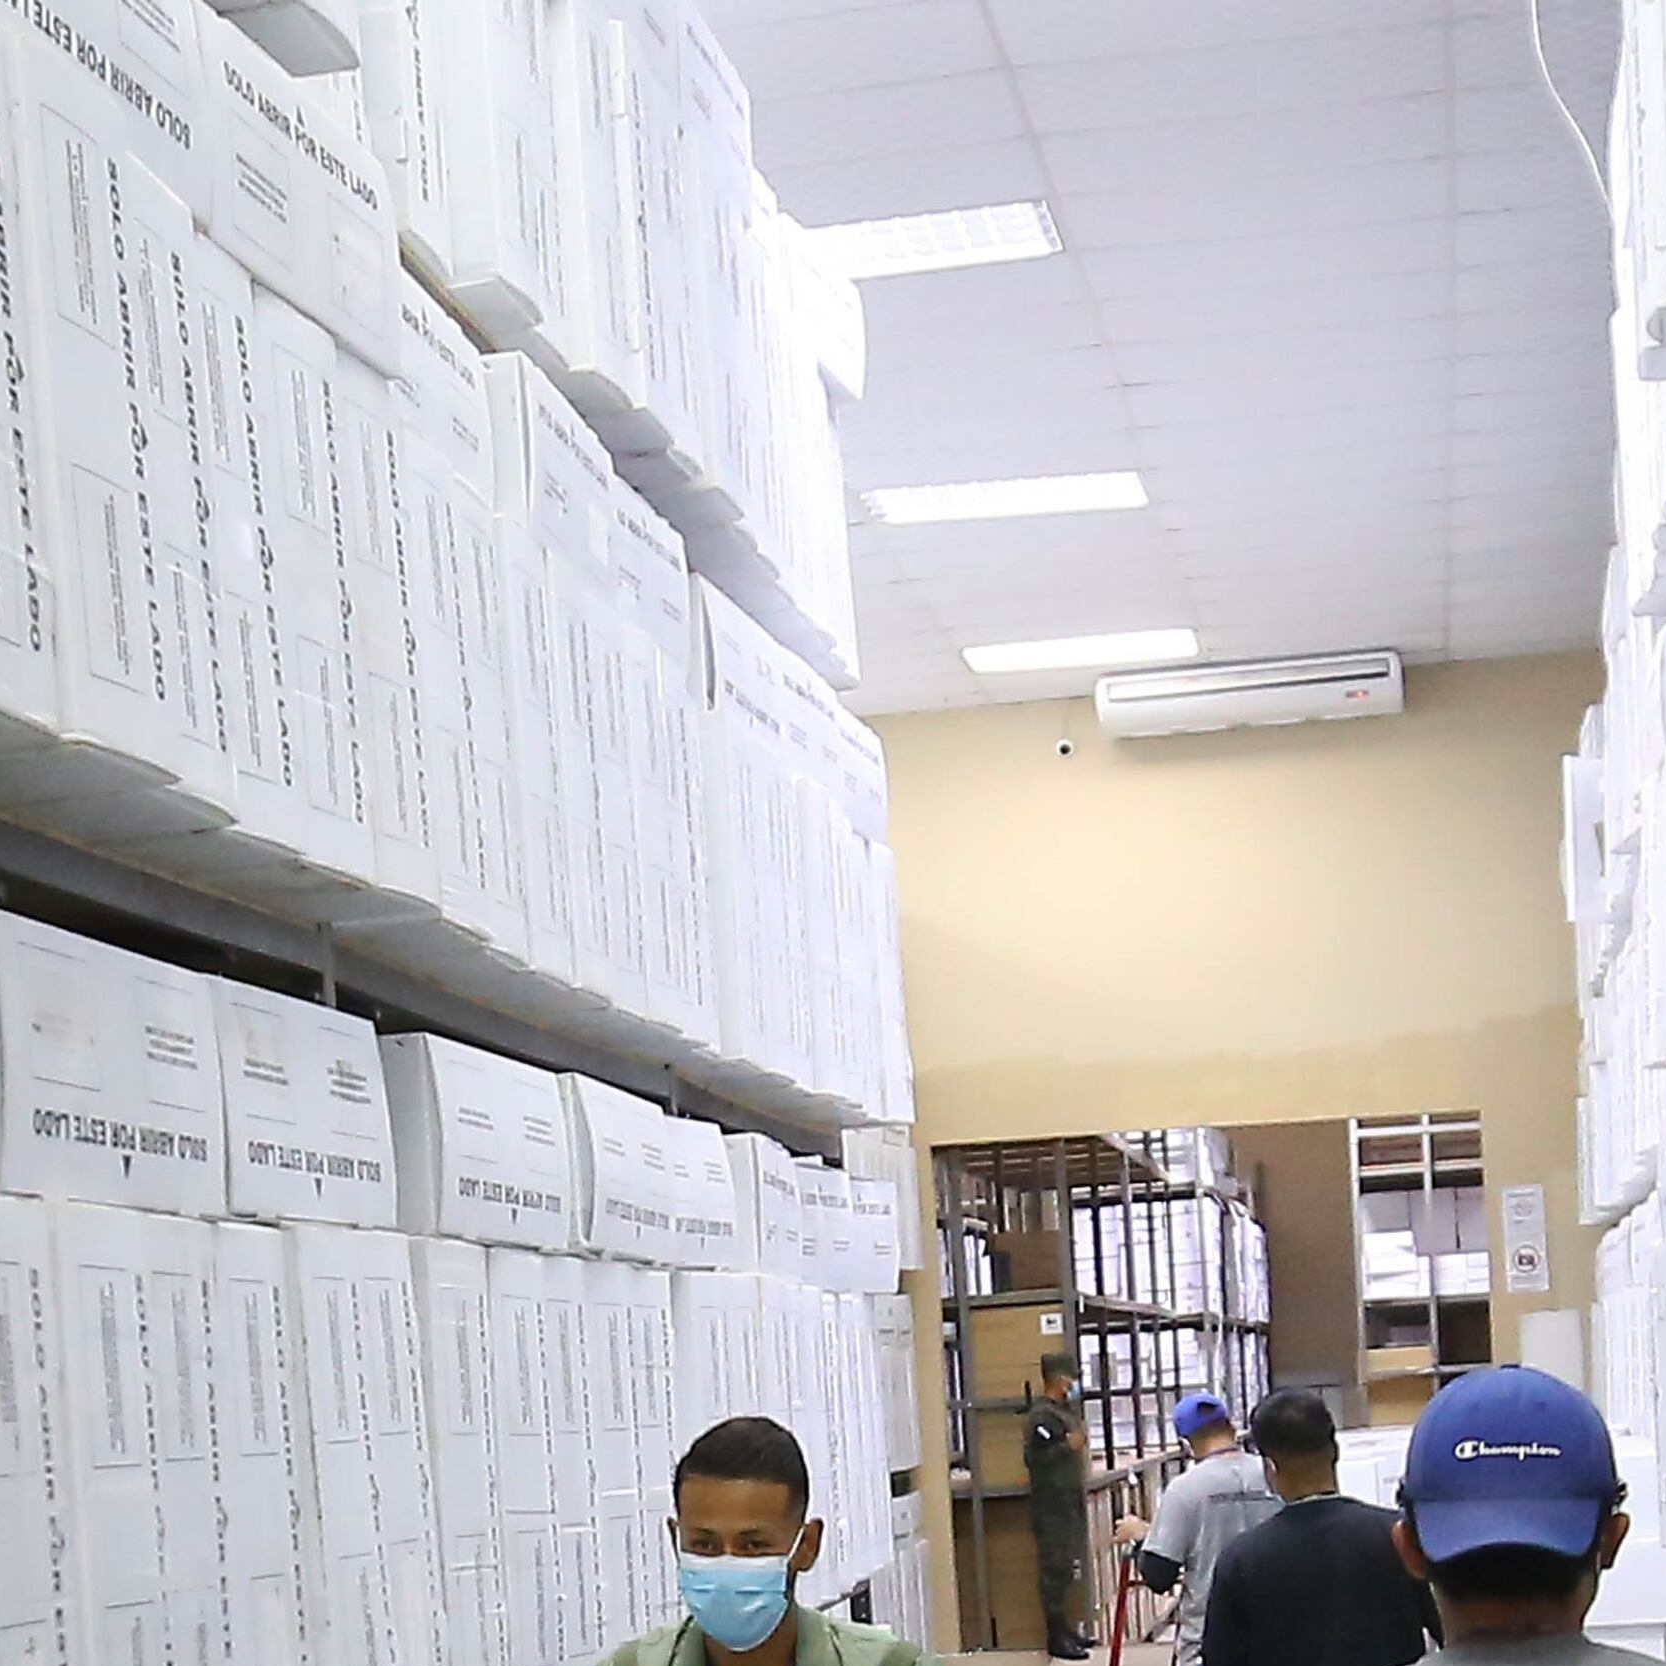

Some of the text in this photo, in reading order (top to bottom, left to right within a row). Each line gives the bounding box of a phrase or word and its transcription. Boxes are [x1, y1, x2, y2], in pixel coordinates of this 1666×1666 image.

[32, 0, 190, 149] SOLO ABRIR POR ESTE
[2, 330, 19, 413] POR
[11, 427, 31, 530] ESTE
[23, 543, 41, 652] LADO
[1454, 1440, 1562, 1461] Champion
